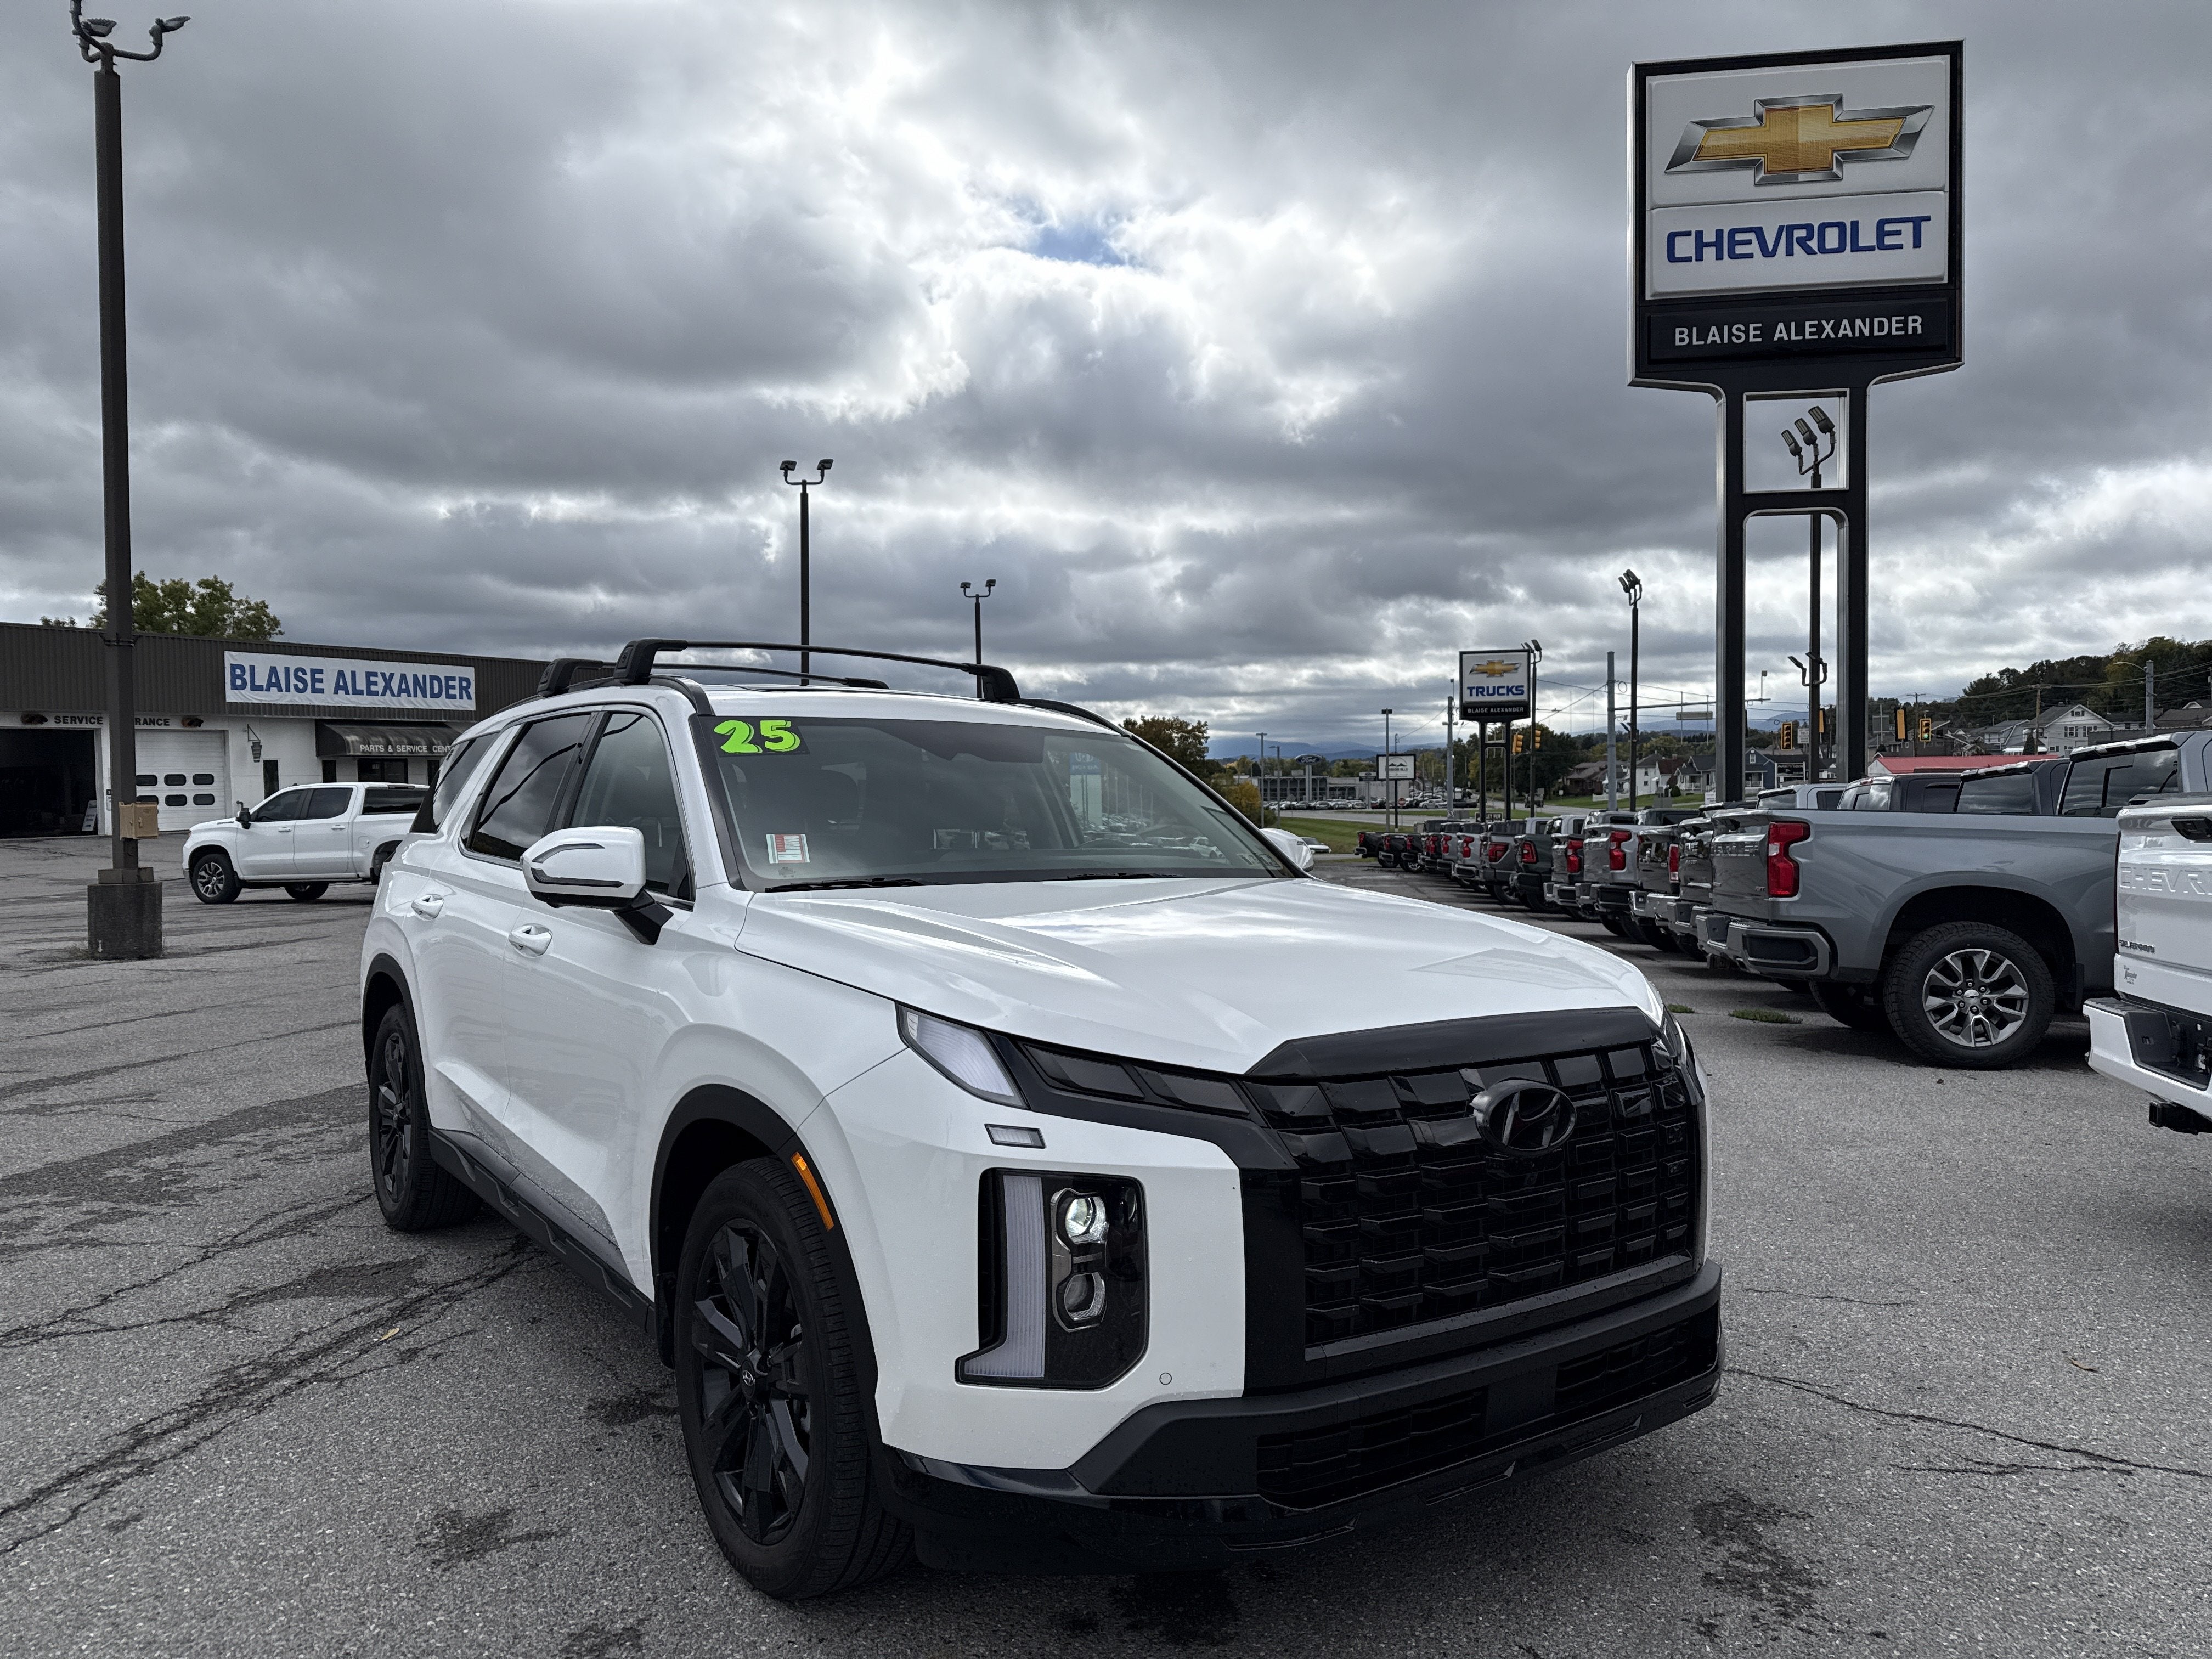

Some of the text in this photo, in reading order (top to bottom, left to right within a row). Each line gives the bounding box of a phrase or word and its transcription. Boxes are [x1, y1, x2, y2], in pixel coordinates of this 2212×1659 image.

[1666, 215, 1931, 263] CHEVROLET
[1674, 315, 1922, 346] BLAISE ALEXANDER
[230, 663, 472, 700] BLAISE ALEXANDER
[1466, 685, 1525, 697] TRUCKS
[54, 715, 170, 726] SERVICE RANCE
[360, 744, 385, 753] PARTS
[396, 744, 428, 753] SERVICE
[713, 720, 800, 754] 25
